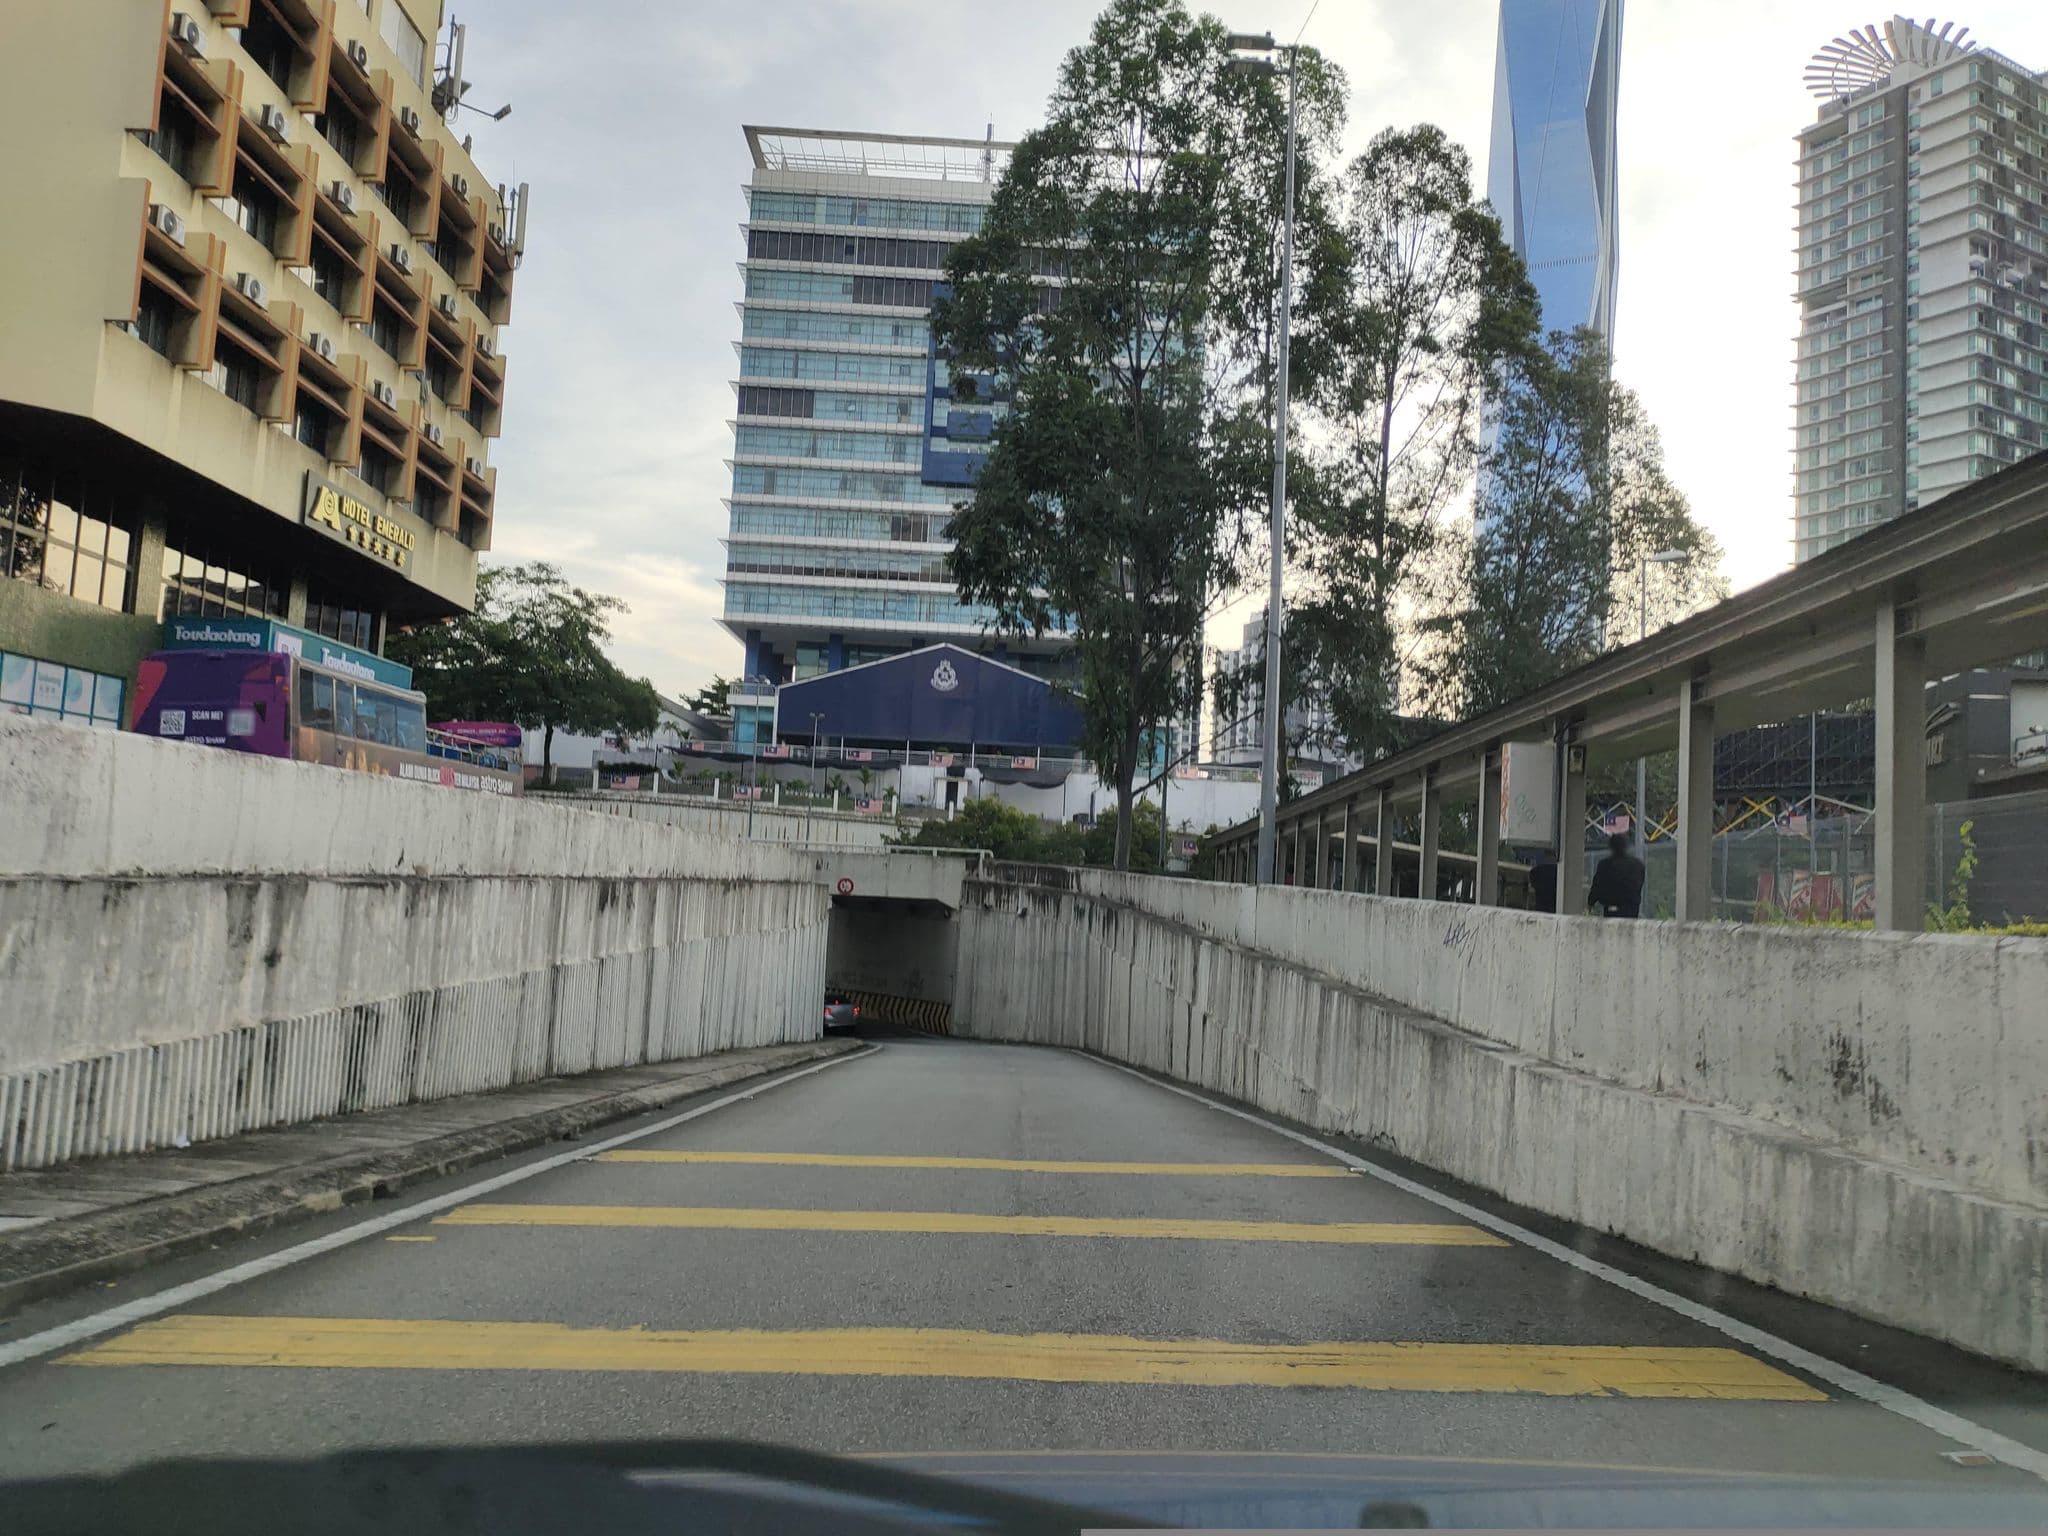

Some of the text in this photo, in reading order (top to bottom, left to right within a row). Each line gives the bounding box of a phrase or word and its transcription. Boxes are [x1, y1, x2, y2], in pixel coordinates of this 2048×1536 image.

[342, 495, 415, 551] HOTEL EMERALD
[174, 624, 261, 648] Toudaotang
[191, 710, 210, 721] SCAN
[498, 779, 514, 795] SHAW
